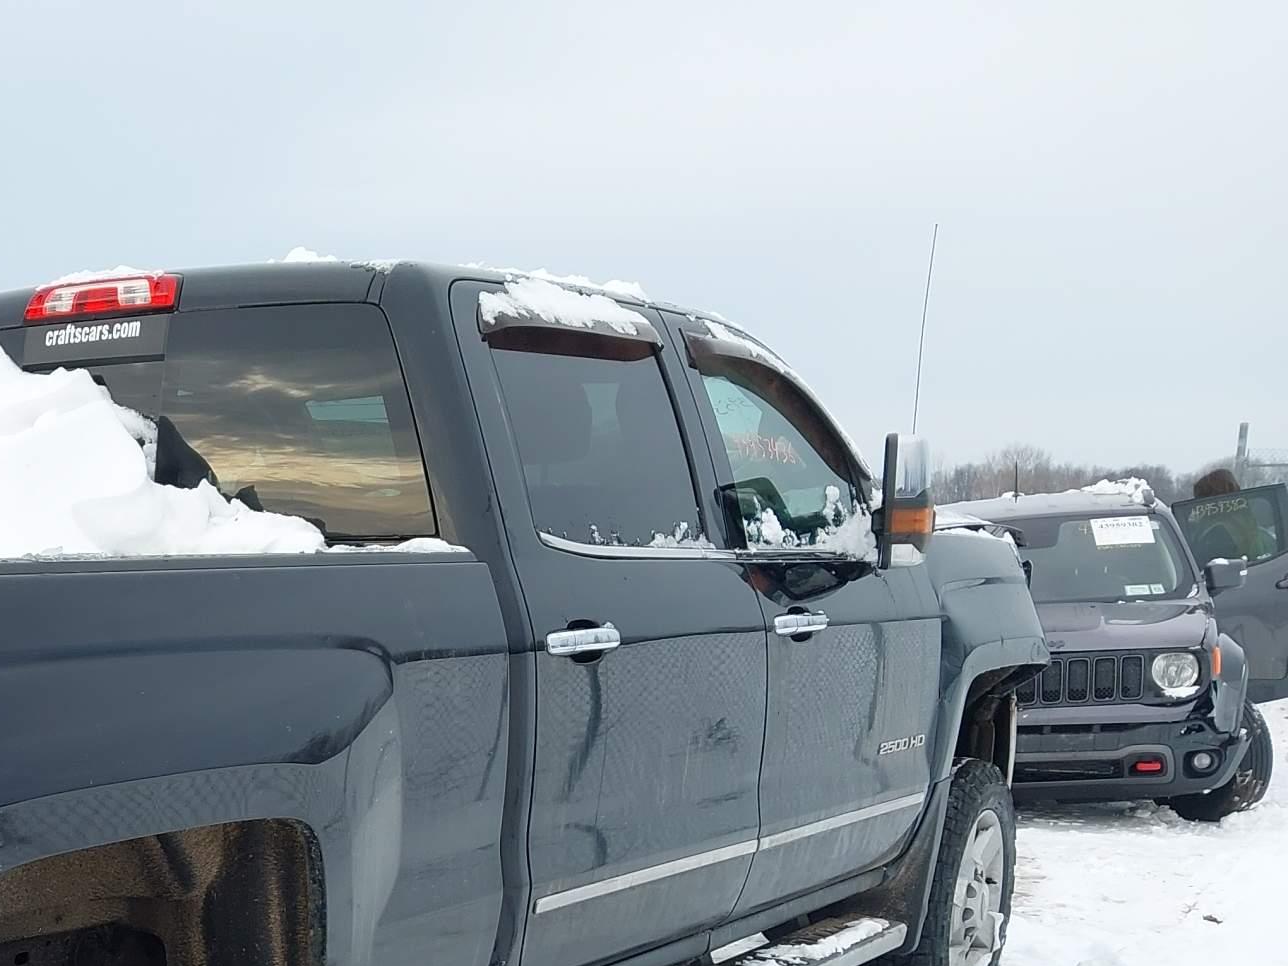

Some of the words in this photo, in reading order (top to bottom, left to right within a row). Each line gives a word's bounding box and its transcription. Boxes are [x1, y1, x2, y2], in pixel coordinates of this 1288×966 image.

[45, 321, 141, 347] craftscars.com
[879, 737, 909, 755] 2500
[909, 734, 925, 749] HD
